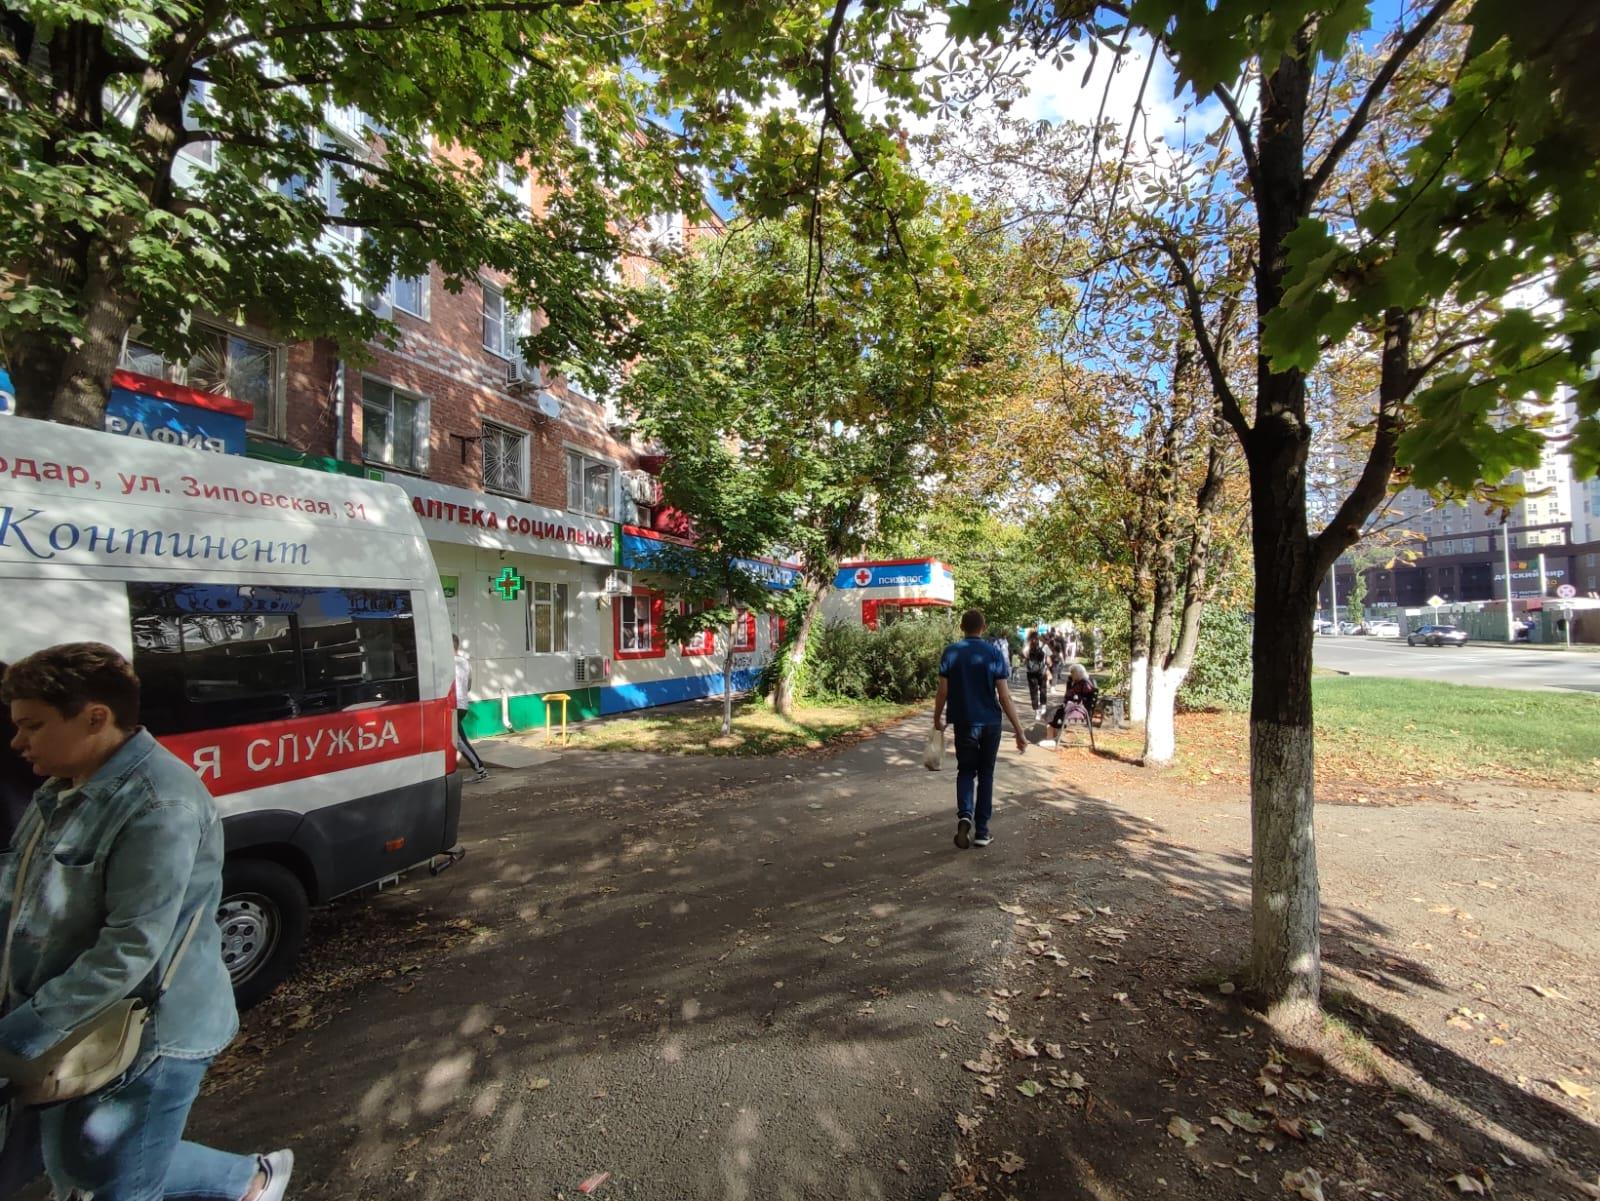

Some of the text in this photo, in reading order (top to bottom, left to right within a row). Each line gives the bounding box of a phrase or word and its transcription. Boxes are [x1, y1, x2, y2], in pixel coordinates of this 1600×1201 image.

[117, 472, 171, 495] ул.
[180, 475, 338, 519] Зиповская,
[344, 501, 368, 521] 31
[412, 496, 614, 550] АПТЕКА СОЦИАЛЬНАЯ
[0, 505, 311, 566] Континент
[246, 719, 401, 772] СЛУЖБА
